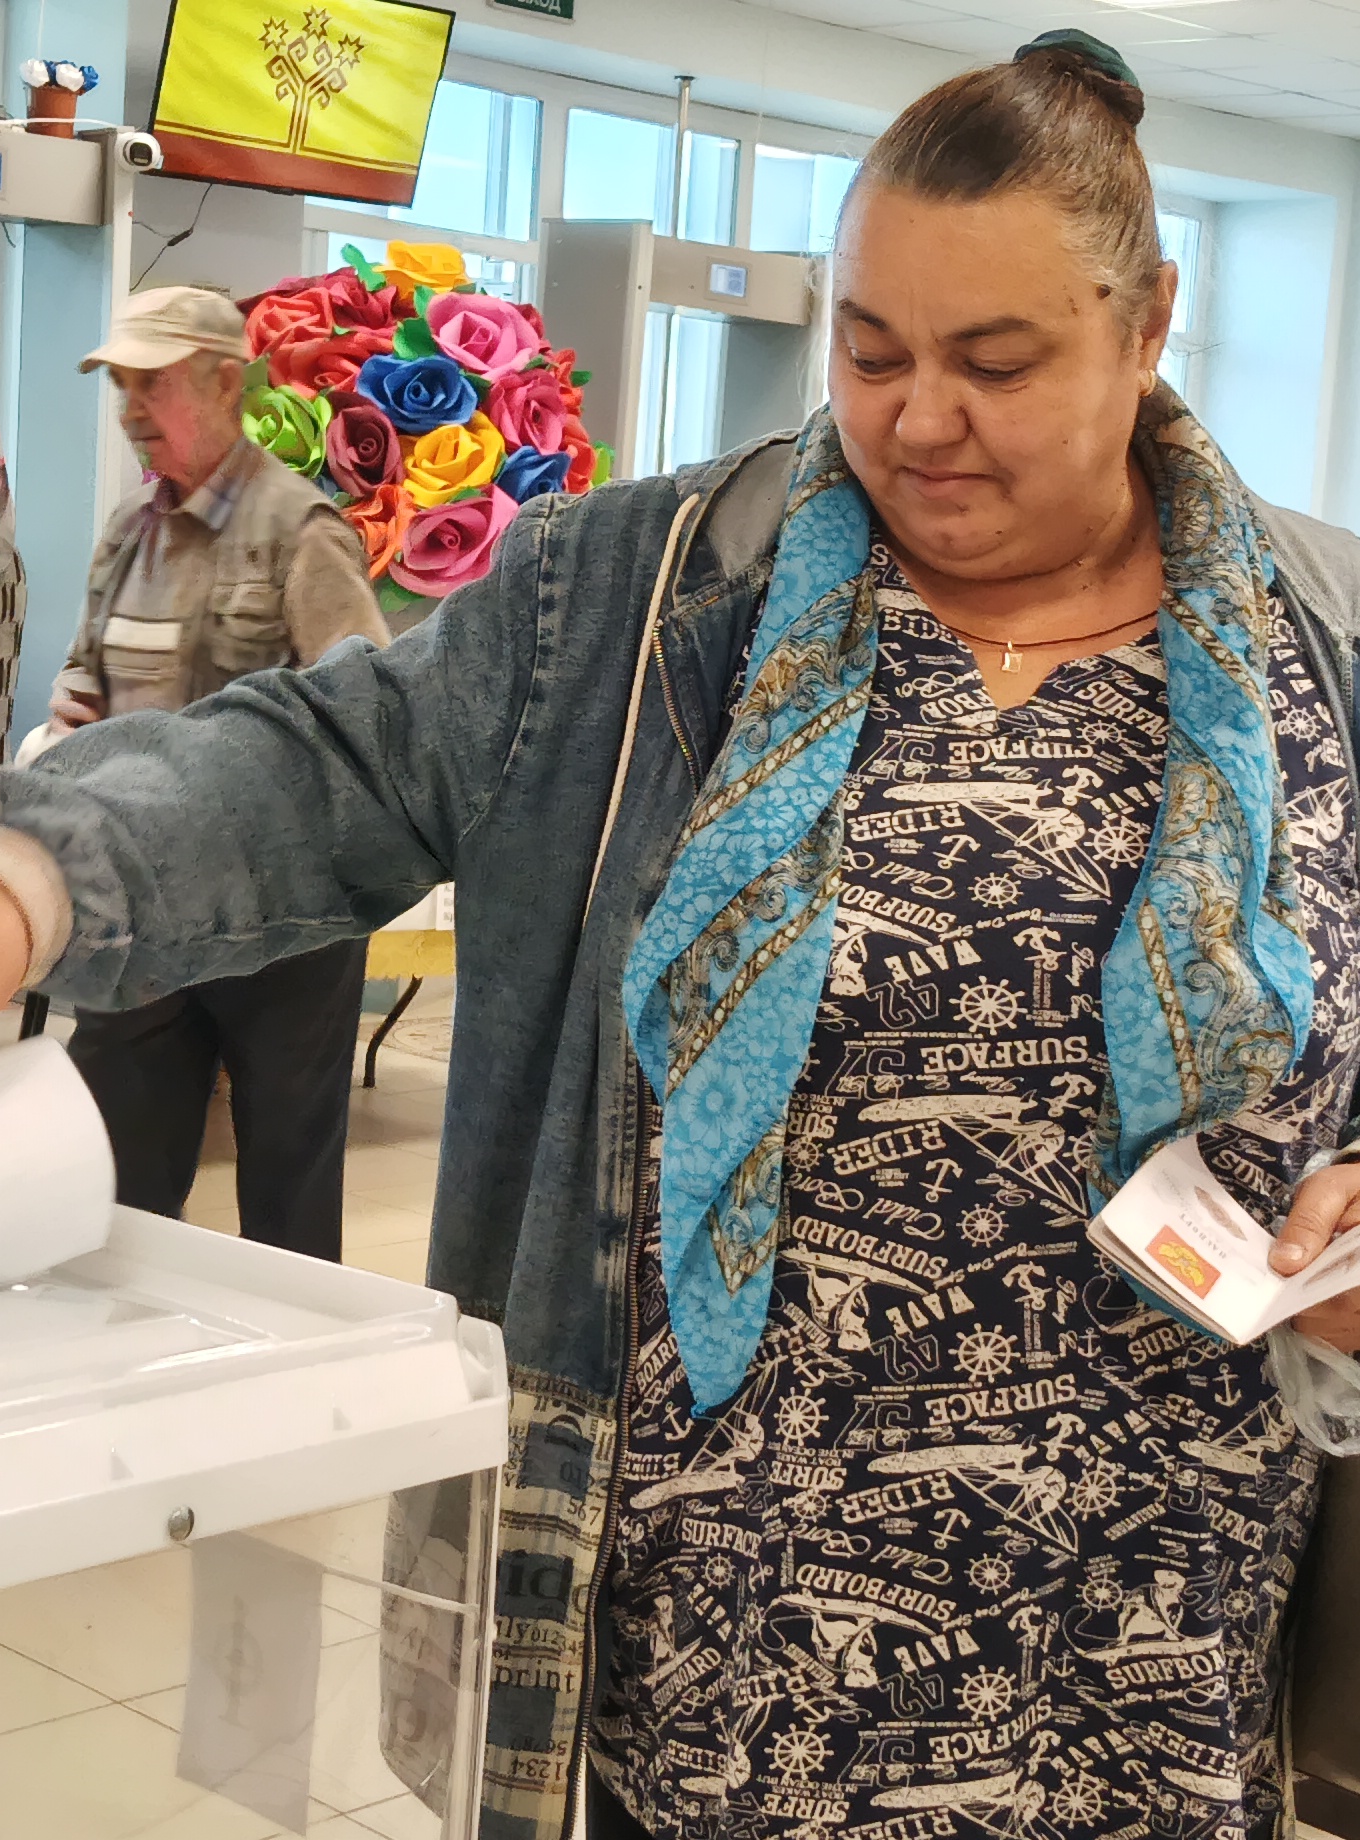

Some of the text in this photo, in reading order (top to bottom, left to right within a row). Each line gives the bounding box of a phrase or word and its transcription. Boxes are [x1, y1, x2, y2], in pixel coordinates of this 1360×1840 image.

[845, 802, 966, 842] RIDER
[884, 939, 982, 982] WAVE
[863, 982, 939, 1029] 42
[920, 1036, 1088, 1073] SURFACE
[825, 1120, 947, 1176] RIDER
[862, 1198, 945, 1242] Tidal
[790, 1214, 948, 1279] SURFBOARD
[885, 1284, 975, 1334] WAVE
[868, 1329, 941, 1383] 42
[924, 1373, 1078, 1424] SURFACE
[835, 1471, 956, 1524] RIDER
[794, 1563, 957, 1621] SURFBOARD
[893, 1630, 980, 1672] WAVE
[492, 1659, 577, 1694] print
[876, 1671, 944, 1719] 42
[928, 1695, 1052, 1763] SURFACE
